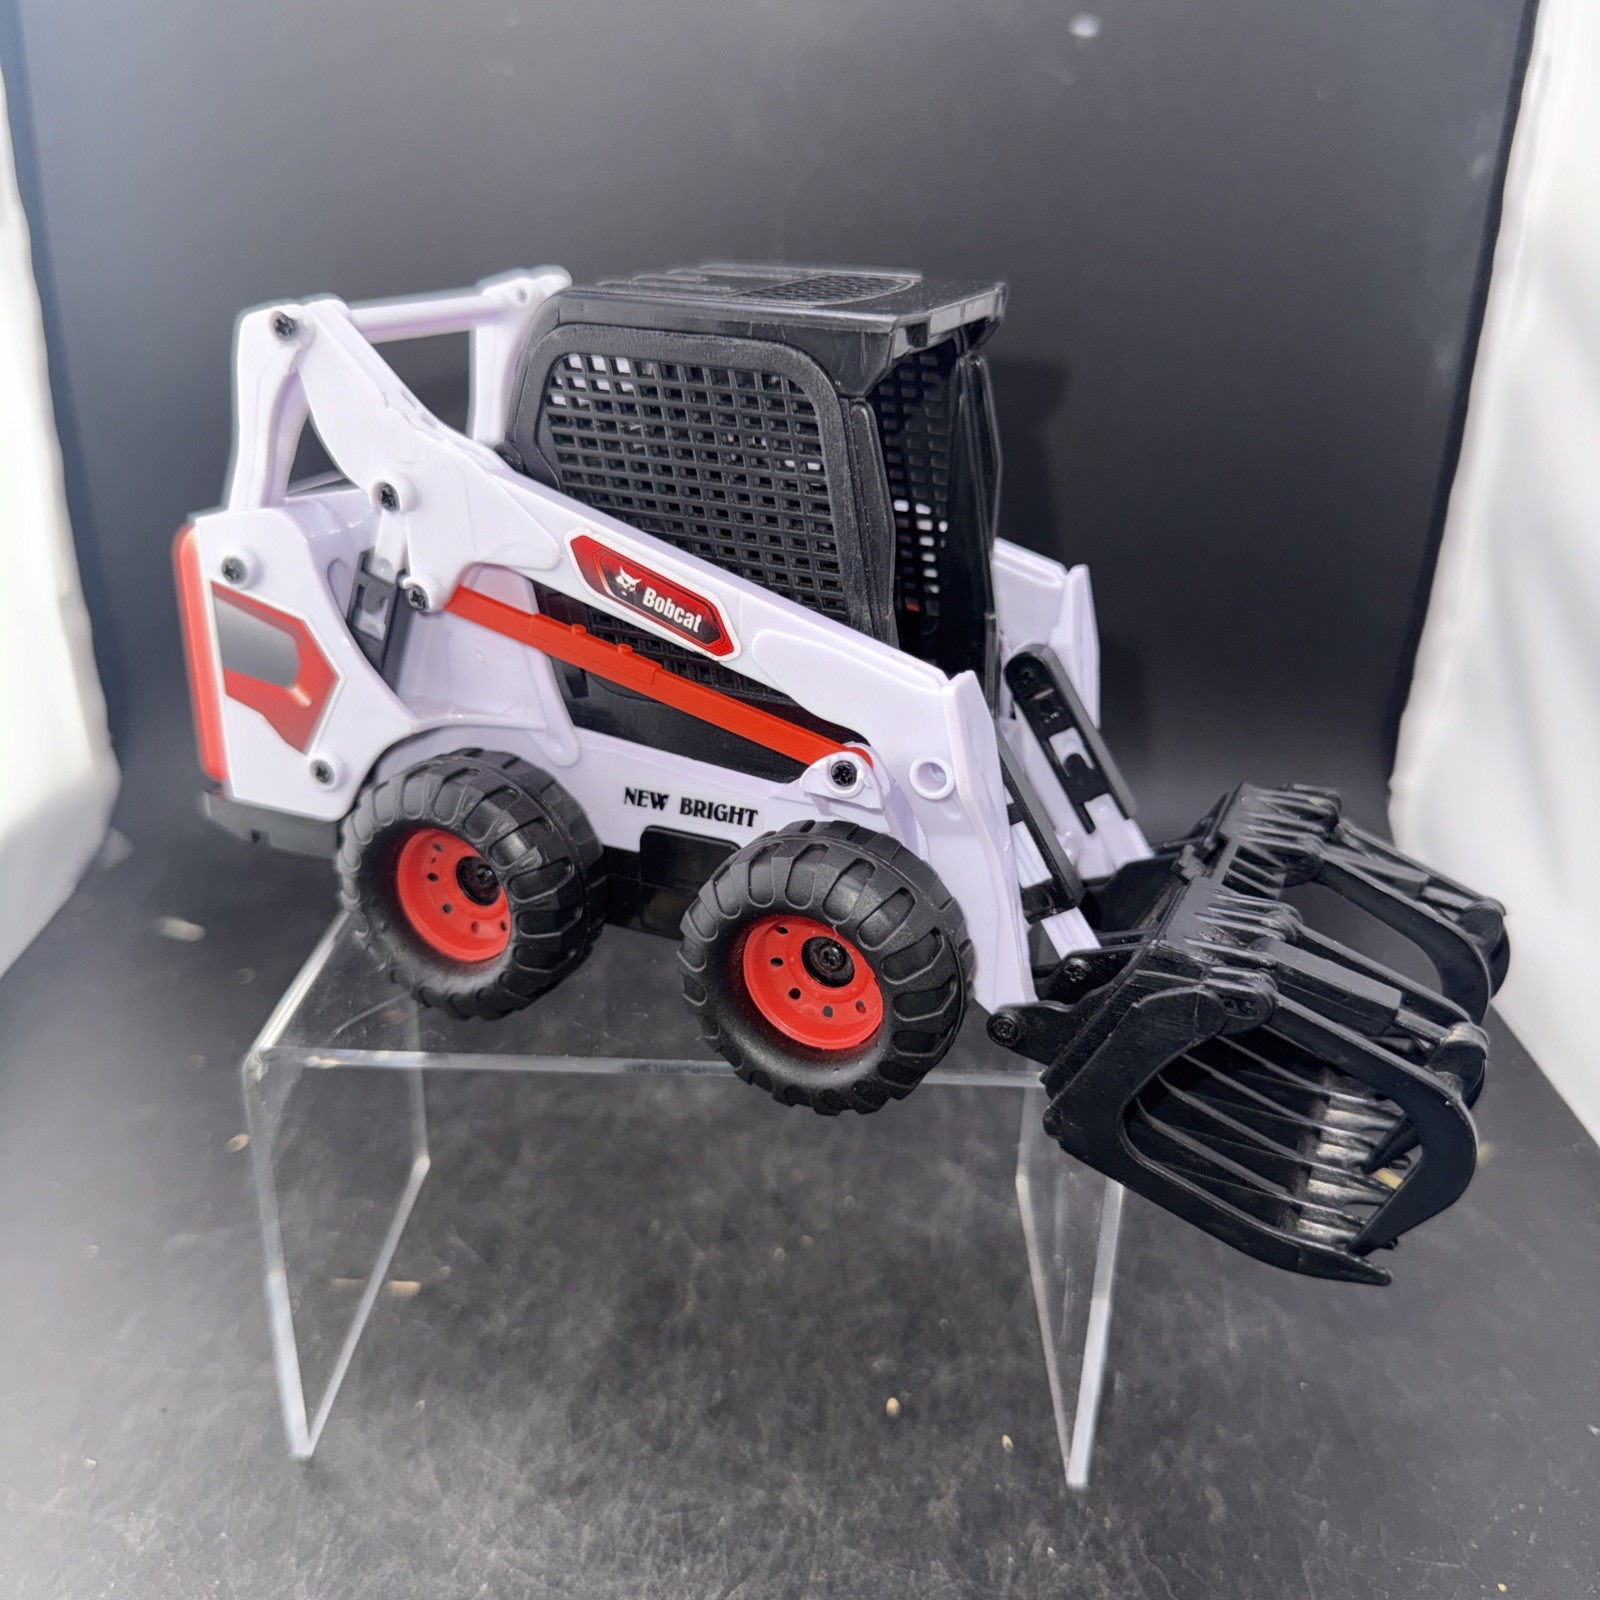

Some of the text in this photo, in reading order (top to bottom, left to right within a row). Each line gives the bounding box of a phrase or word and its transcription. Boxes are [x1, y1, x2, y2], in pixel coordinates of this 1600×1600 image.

[642, 587, 703, 633] Bobcat
[624, 787, 759, 828] NEW BRIGHT
